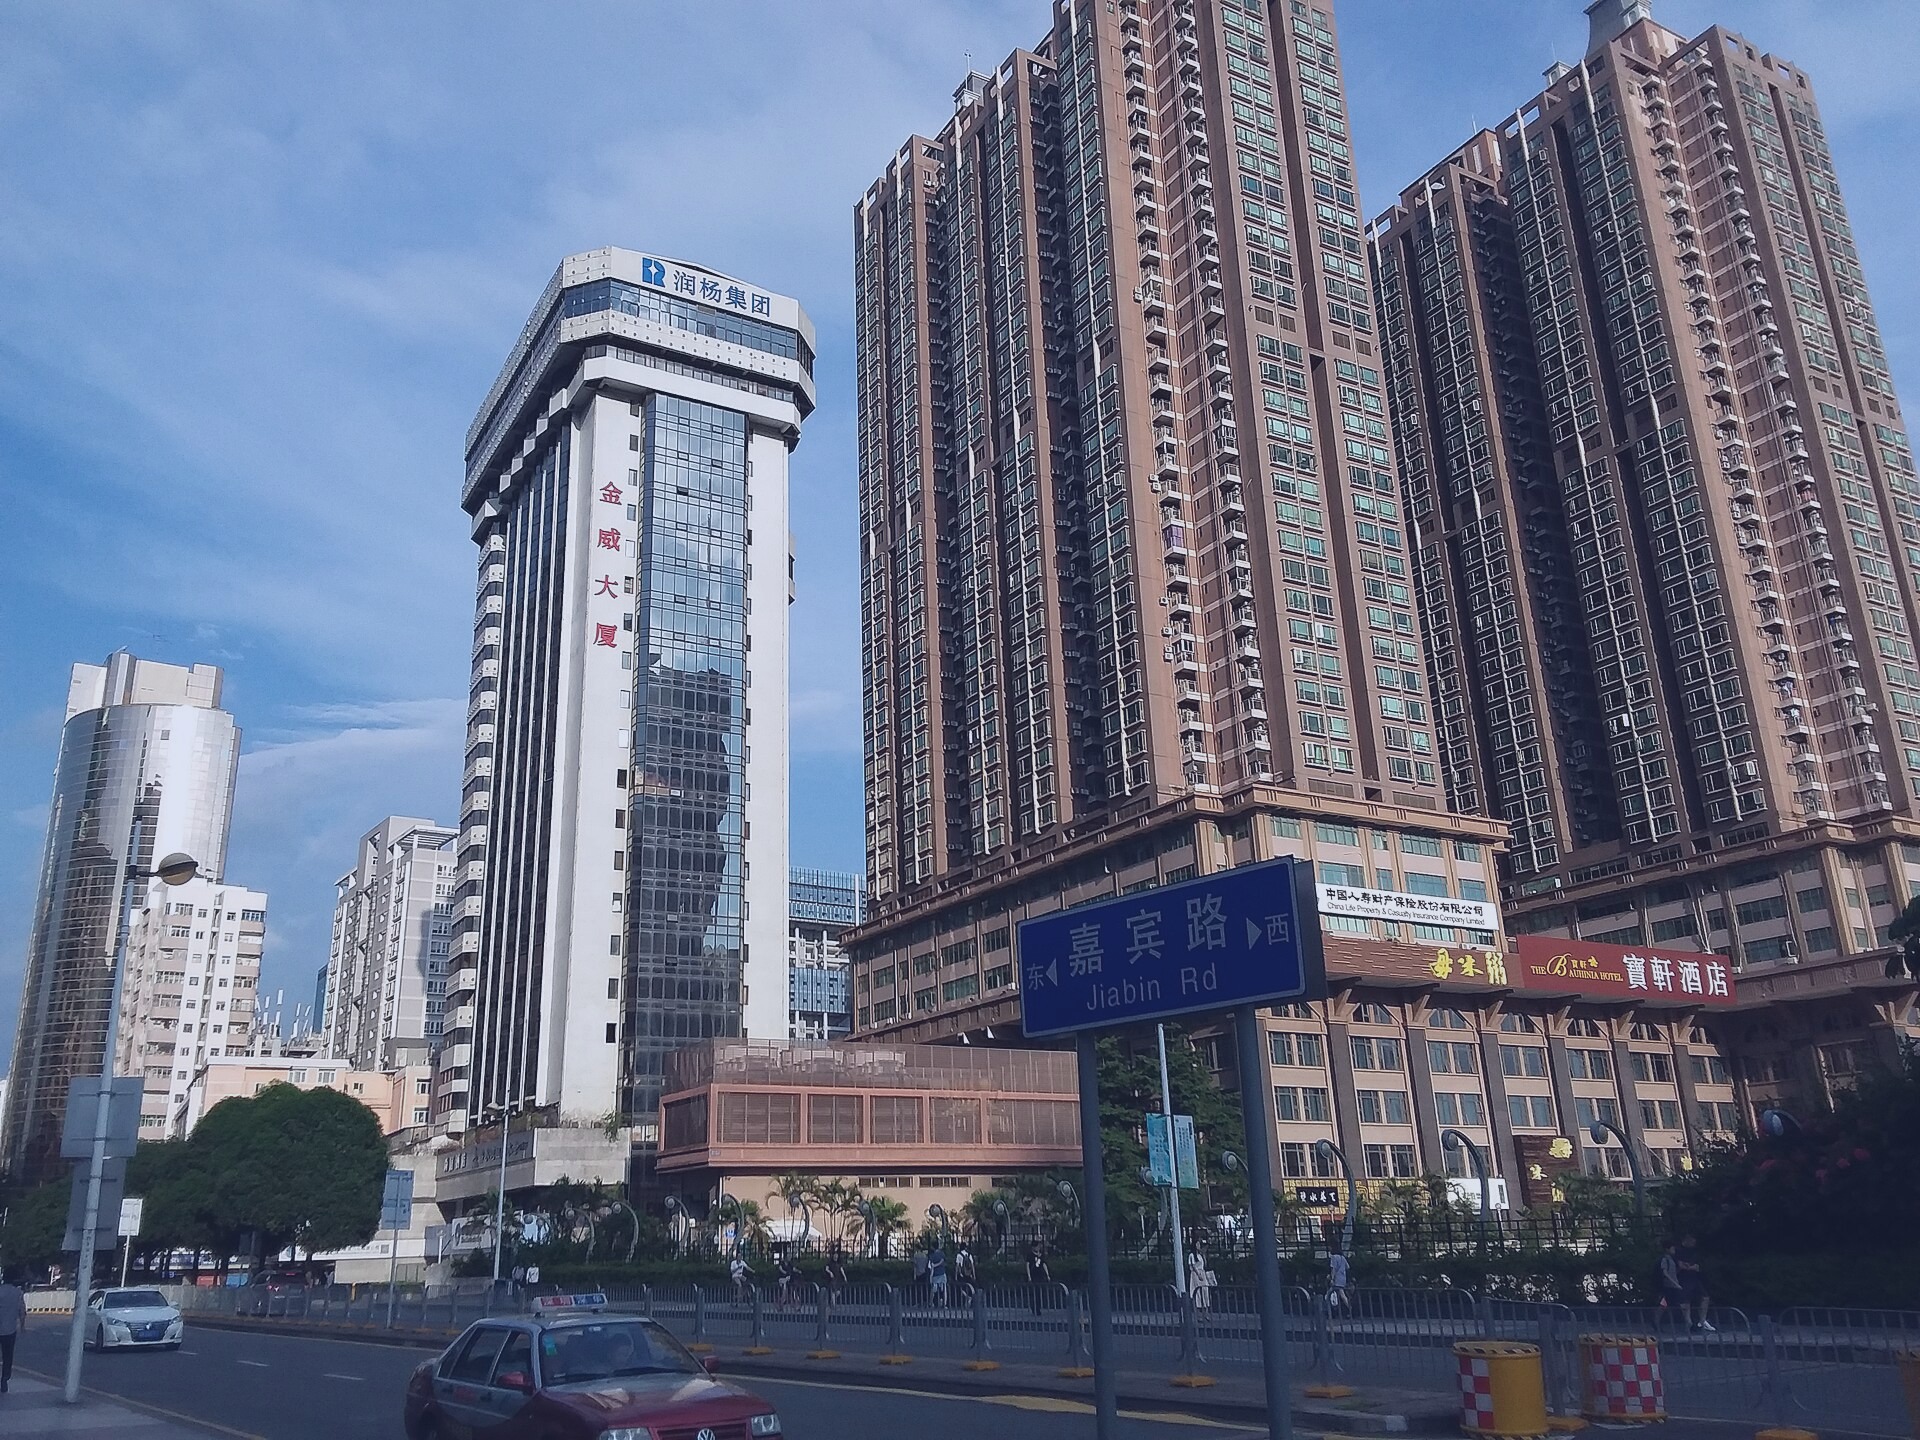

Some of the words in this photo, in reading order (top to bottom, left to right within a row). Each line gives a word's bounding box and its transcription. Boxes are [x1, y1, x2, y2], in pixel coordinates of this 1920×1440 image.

[673, 269, 772, 318] 润杨集团
[593, 481, 623, 648] 金威大厦
[1325, 887, 1484, 917] 中国人寿财产保险股份有限公司
[1327, 901, 1344, 911] China
[1413, 911, 1439, 921] Insurance
[1440, 914, 1465, 925] Company
[1068, 892, 1228, 978] 嘉宾路
[1264, 913, 1290, 945] 西
[1026, 962, 1044, 992] 东
[1086, 975, 1162, 1011] Jiabin
[1180, 962, 1218, 995] Rd
[1530, 965, 1547, 975] THE
[1600, 971, 1624, 982] HOTEL
[1622, 953, 1730, 997] 寶軒酒店
